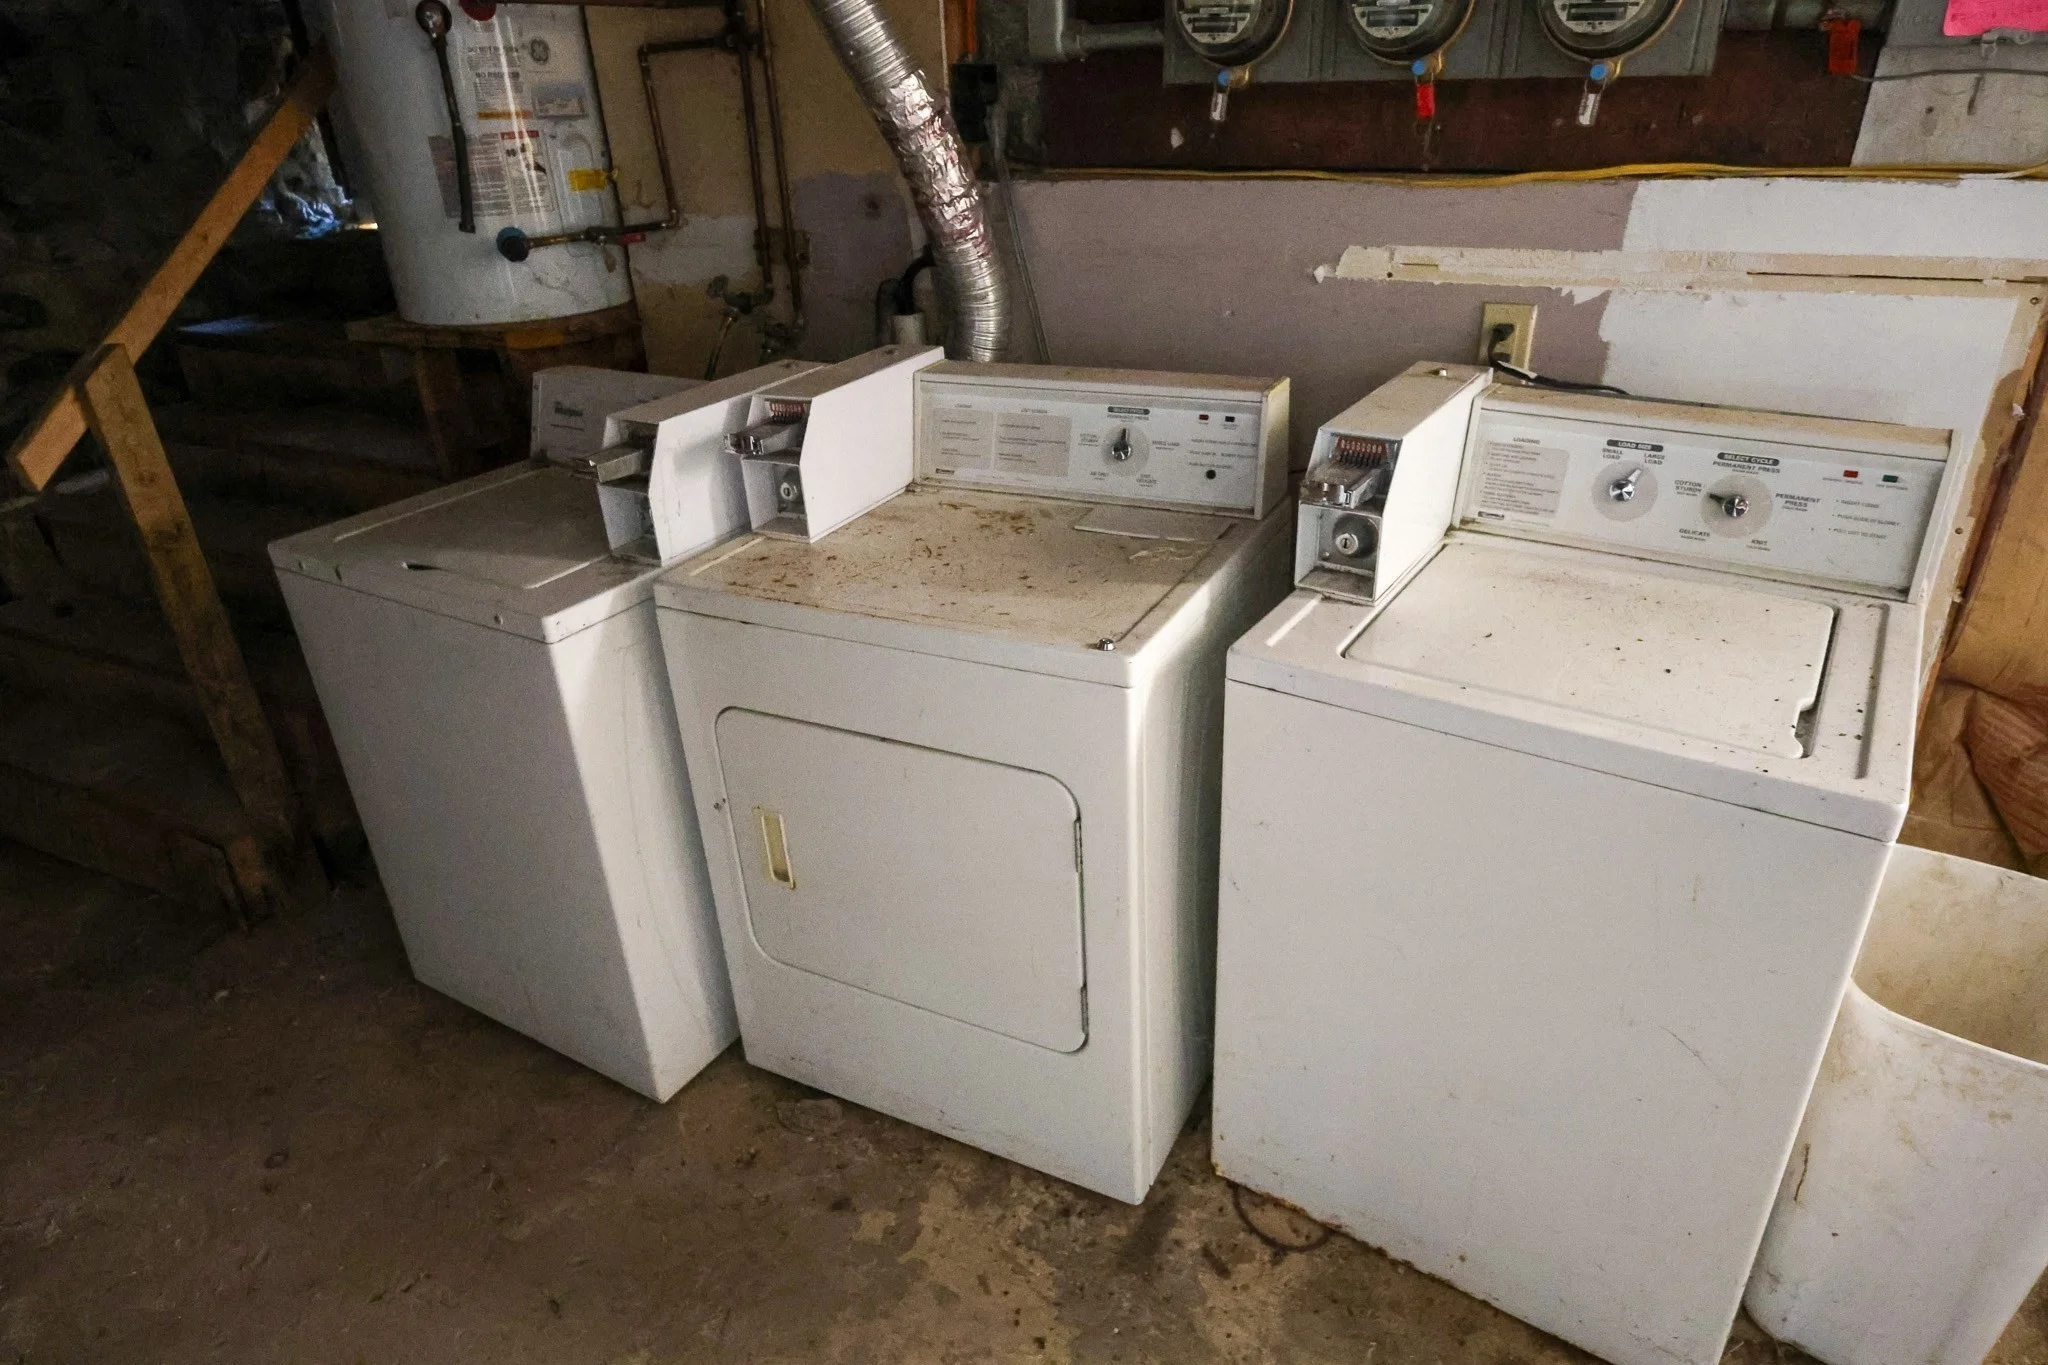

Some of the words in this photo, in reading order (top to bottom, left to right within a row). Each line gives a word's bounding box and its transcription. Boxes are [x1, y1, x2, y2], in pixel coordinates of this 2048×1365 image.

[1513, 437, 1540, 445] LOADING
[1618, 441, 1637, 449] LOAD
[1723, 454, 1750, 463] SELECT
[1750, 456, 1774, 465] CYCLE
[1712, 461, 1756, 471] PERMANENT
[1757, 466, 1780, 474] PRESS
[1775, 493, 1821, 503] PERMANENT
[1784, 500, 1808, 508] PRESS
[1679, 528, 1711, 538] DELICATE
